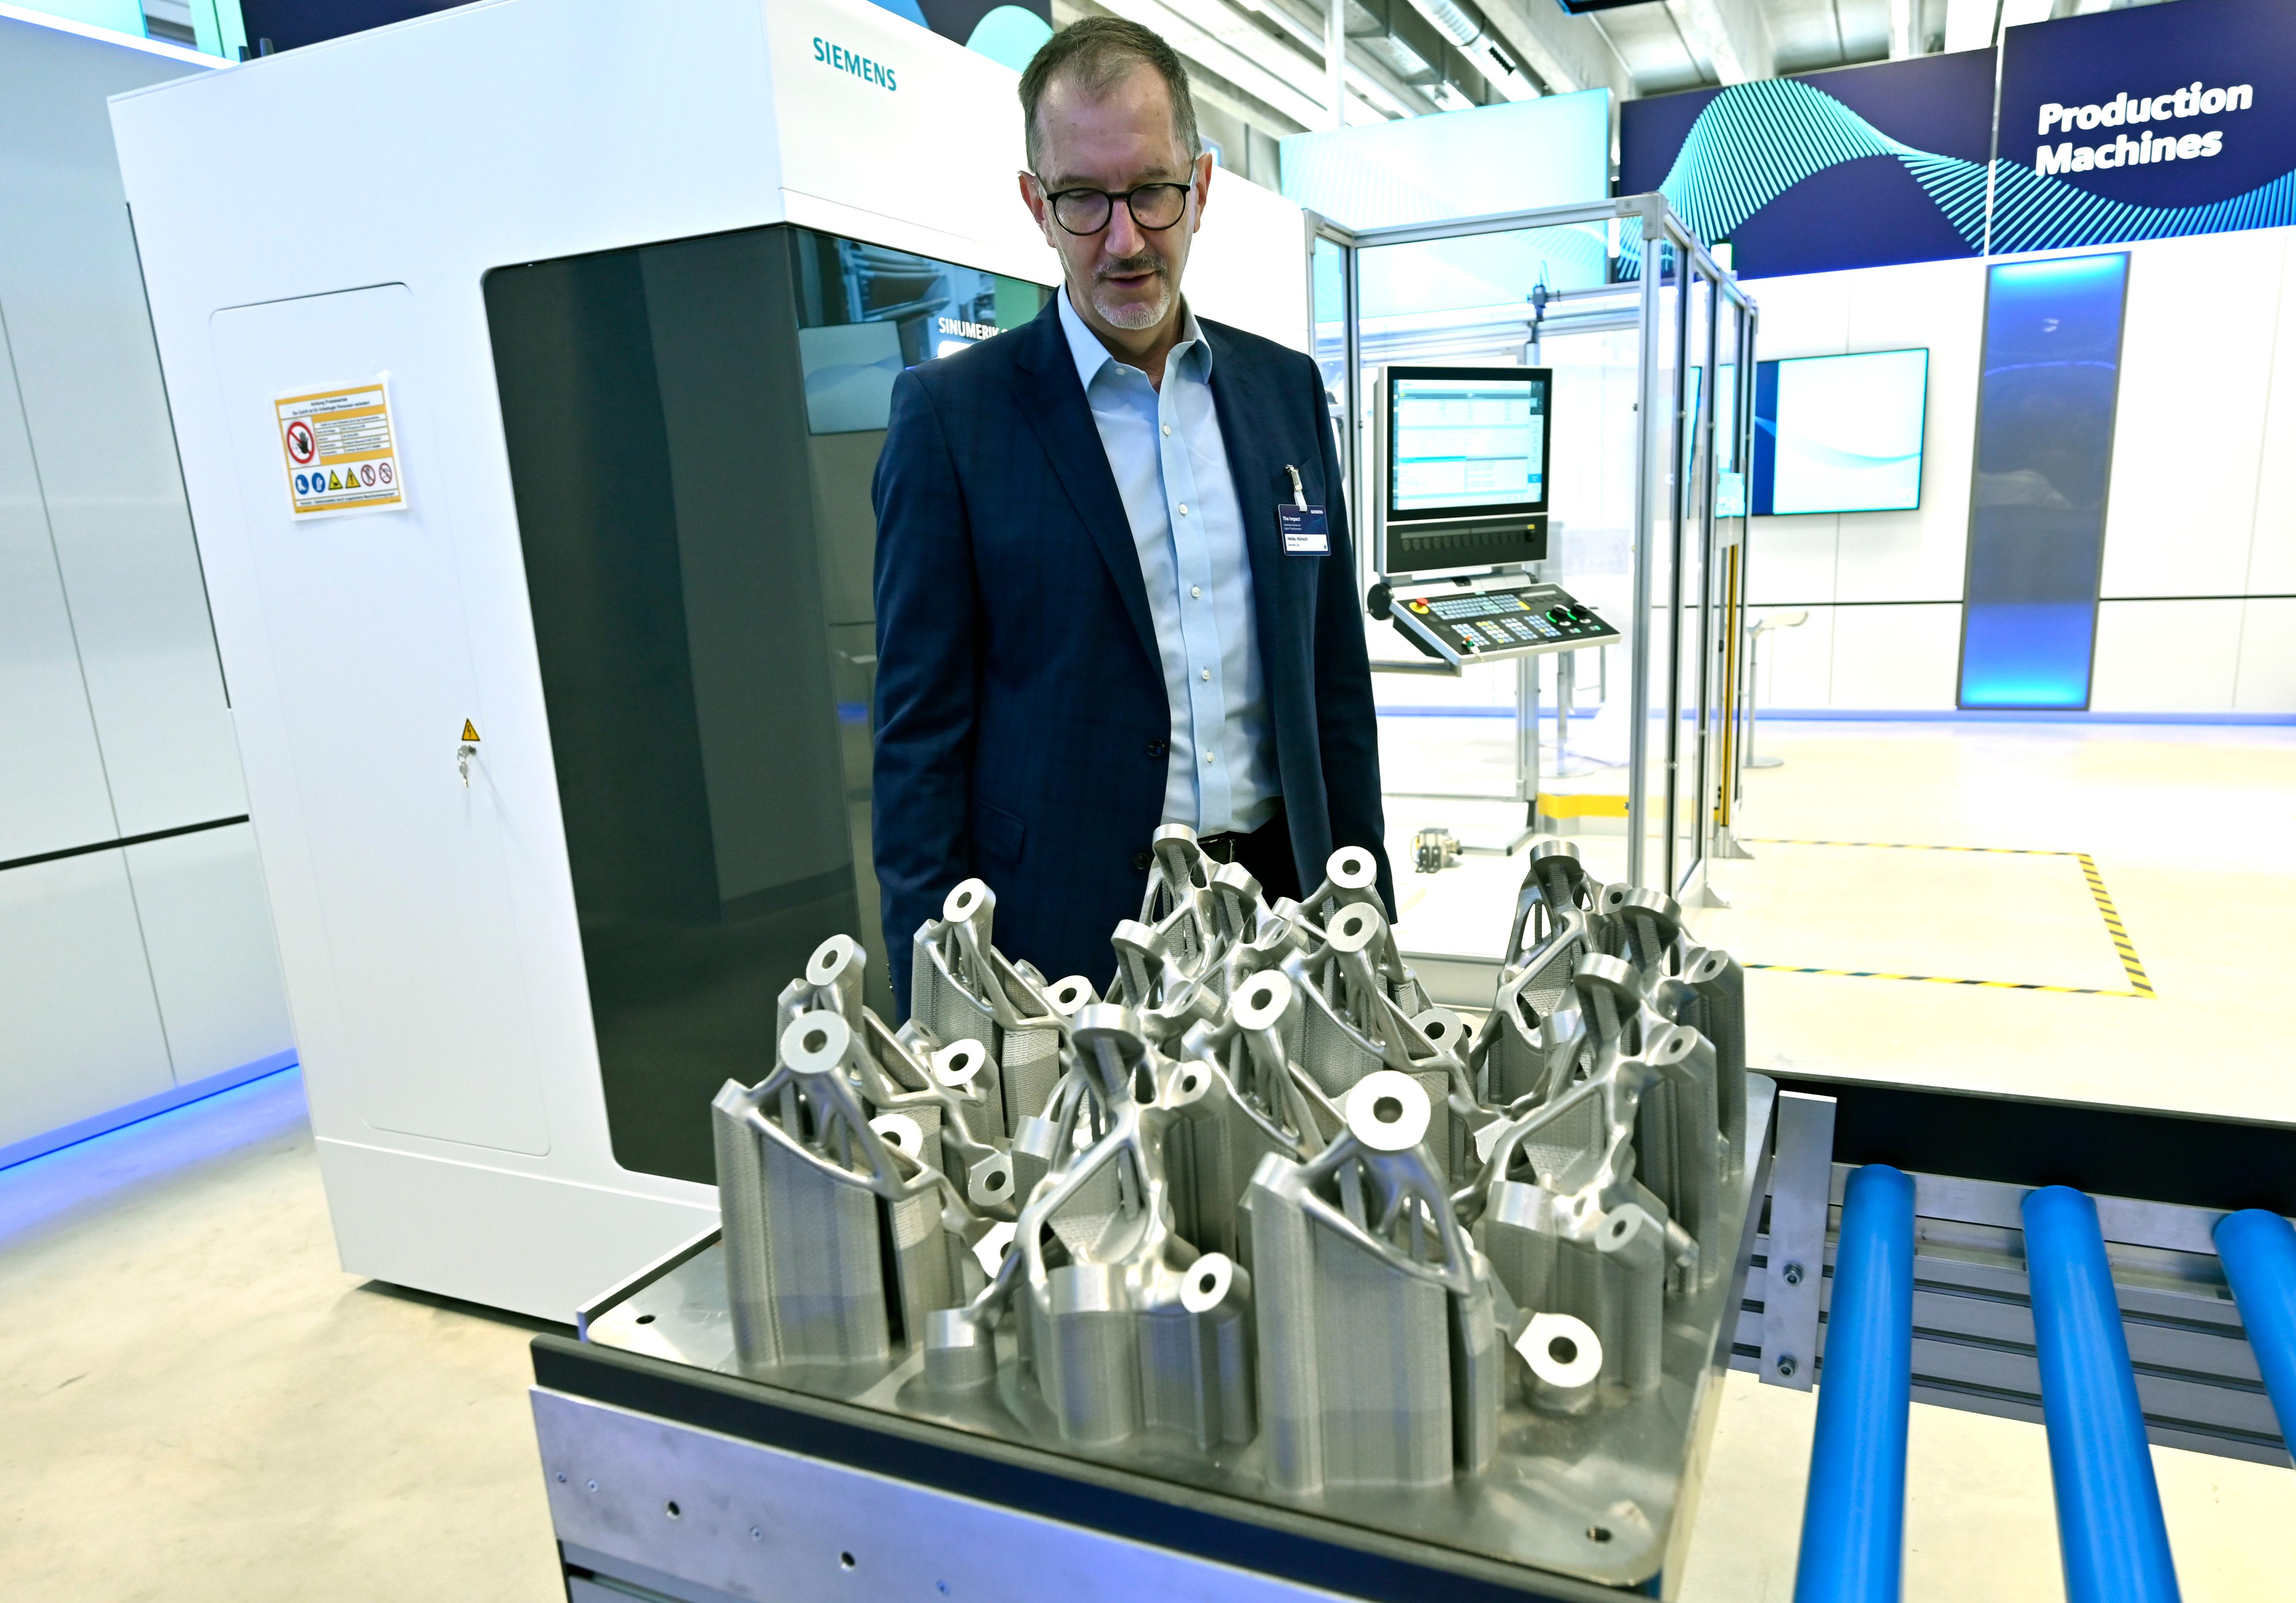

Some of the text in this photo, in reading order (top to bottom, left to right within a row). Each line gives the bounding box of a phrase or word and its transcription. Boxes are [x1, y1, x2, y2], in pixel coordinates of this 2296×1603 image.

[813, 37, 897, 91] SIEMENS
[2038, 81, 2253, 135] Production
[2035, 130, 2223, 176] Machines
